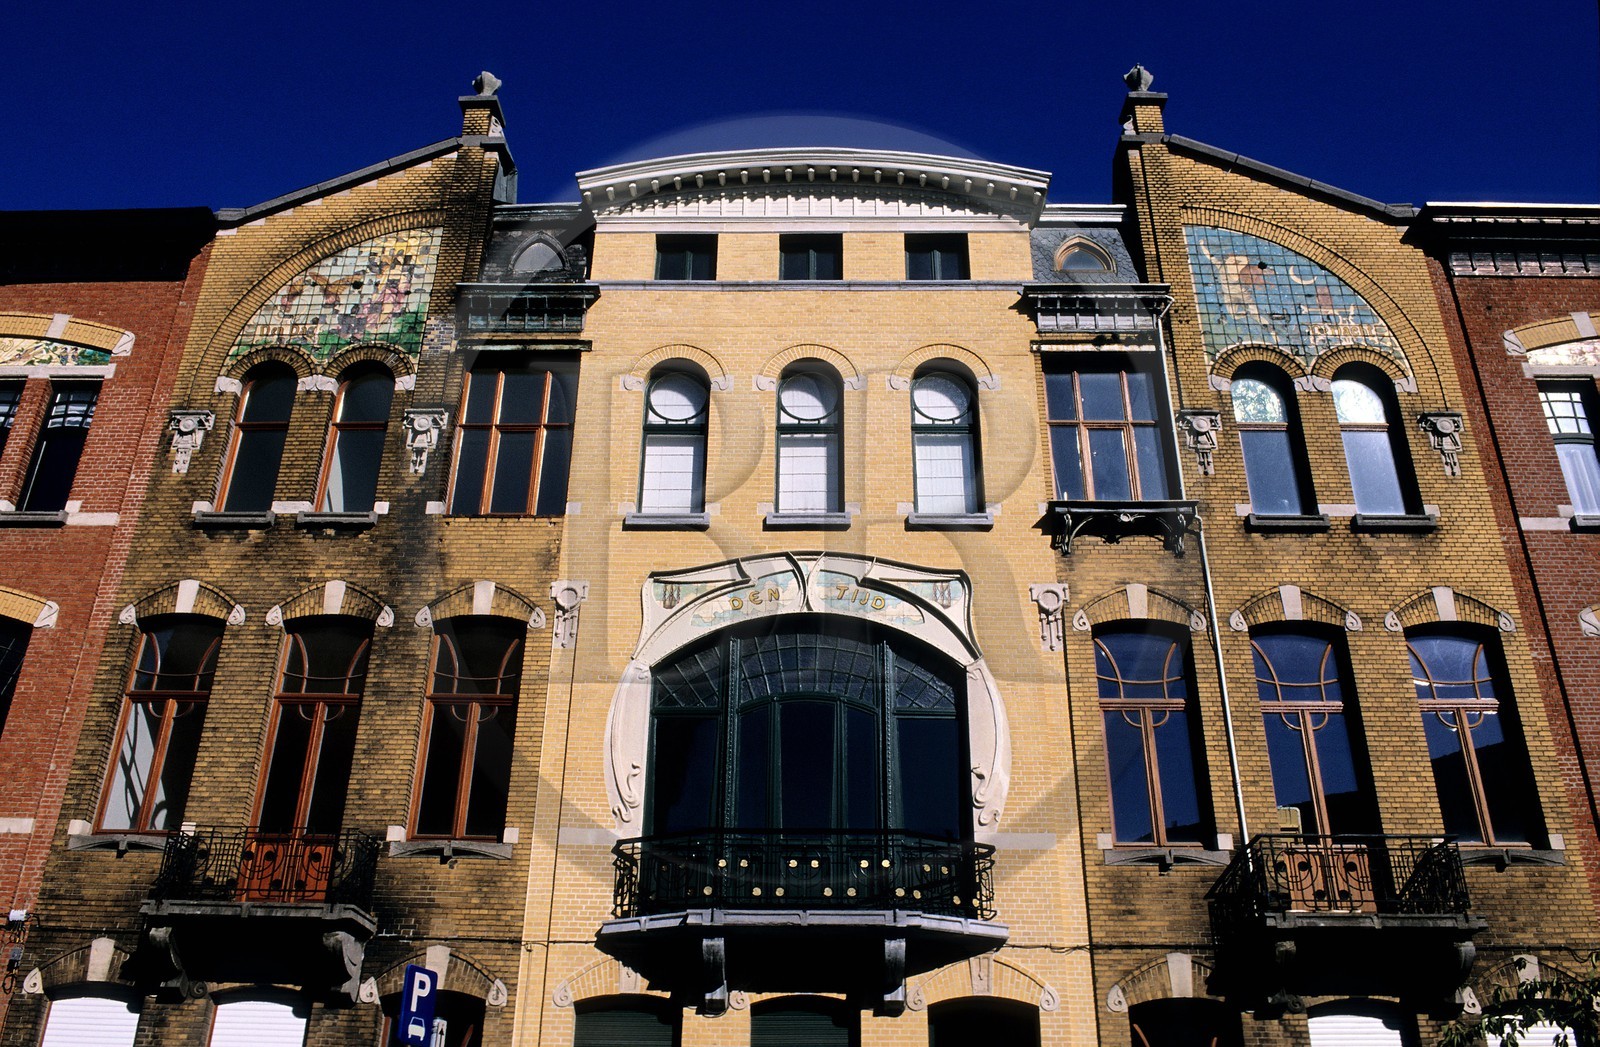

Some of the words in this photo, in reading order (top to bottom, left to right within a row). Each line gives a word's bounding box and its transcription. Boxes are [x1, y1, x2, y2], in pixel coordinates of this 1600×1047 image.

[729, 588, 780, 611] DEN
[835, 585, 886, 611] TIJD
[410, 971, 431, 1012] P
